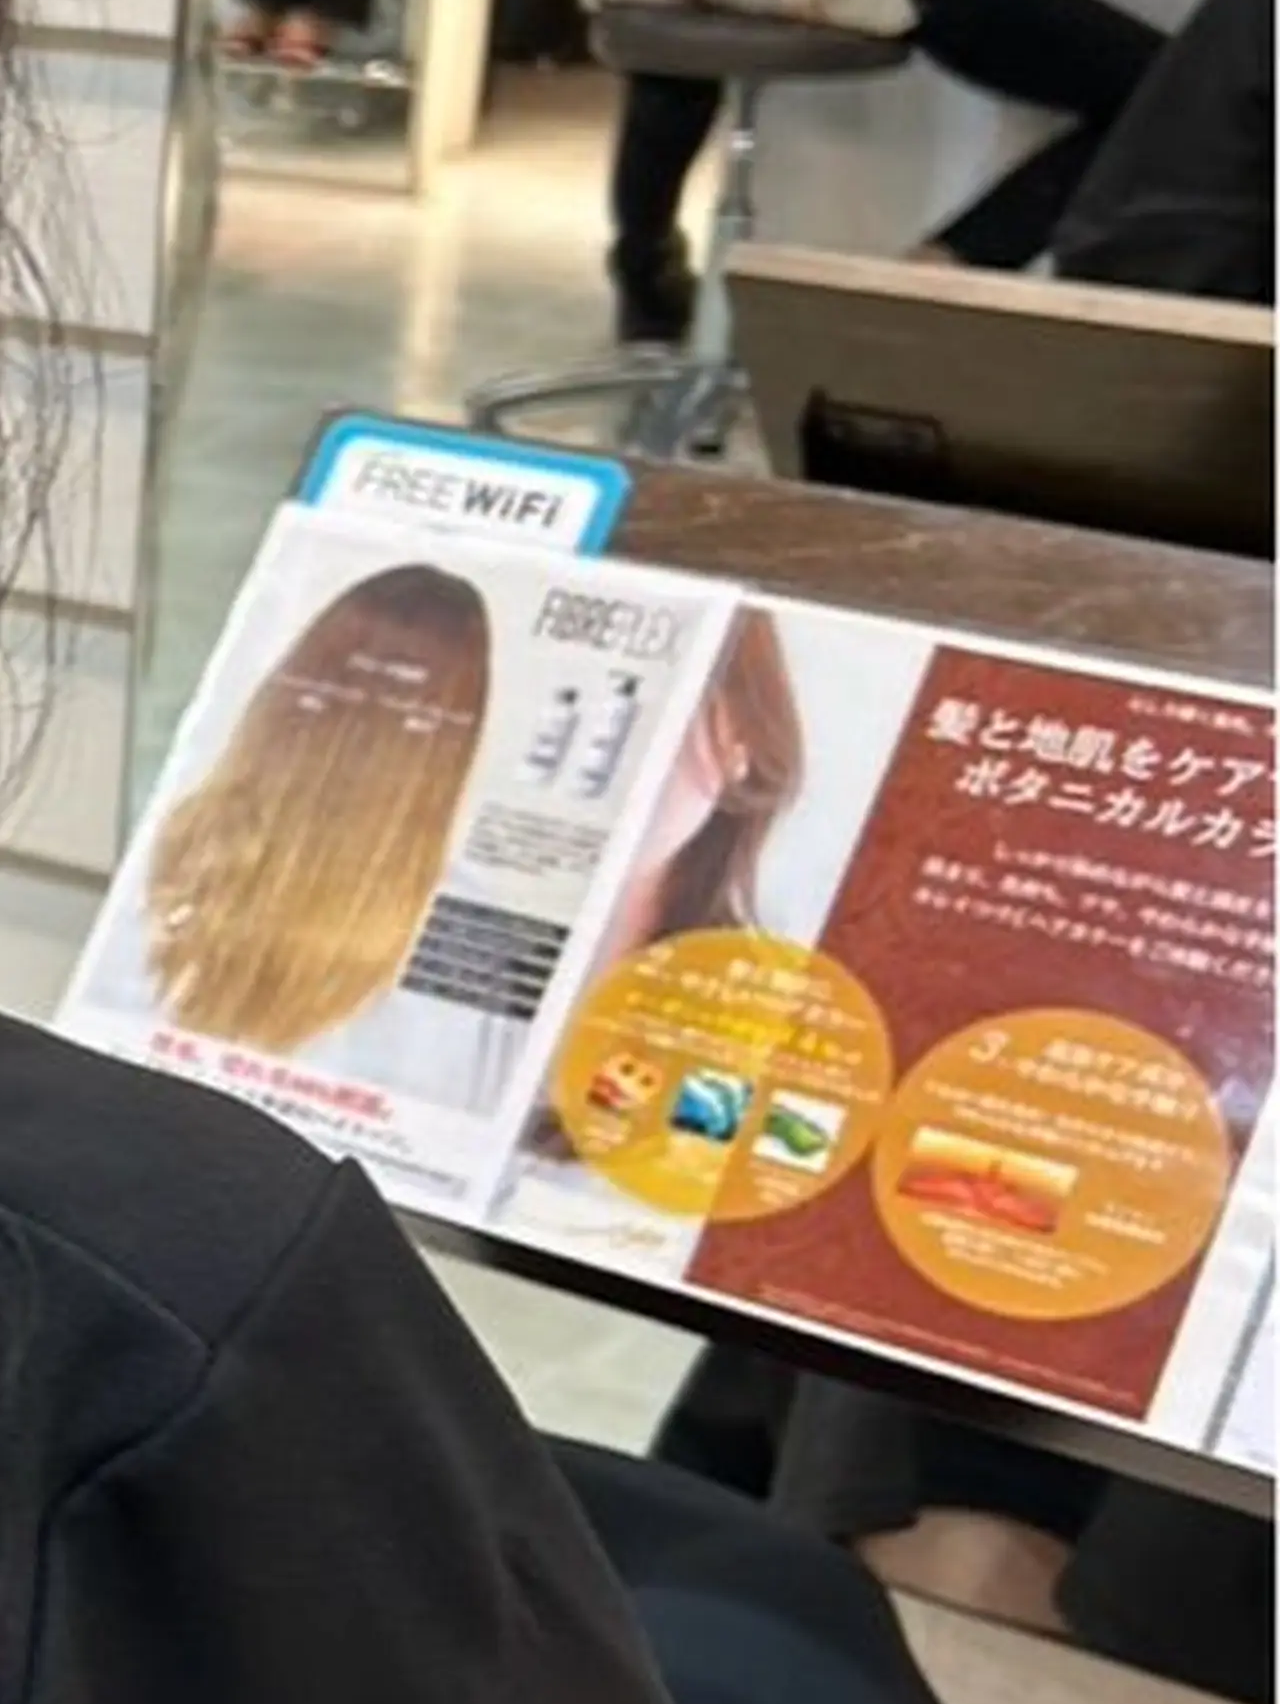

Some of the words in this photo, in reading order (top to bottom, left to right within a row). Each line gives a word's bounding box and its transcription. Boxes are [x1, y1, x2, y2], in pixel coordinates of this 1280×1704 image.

[353, 457, 460, 512] FREE
[925, 696, 1276, 797] 髪と地肌をケア
